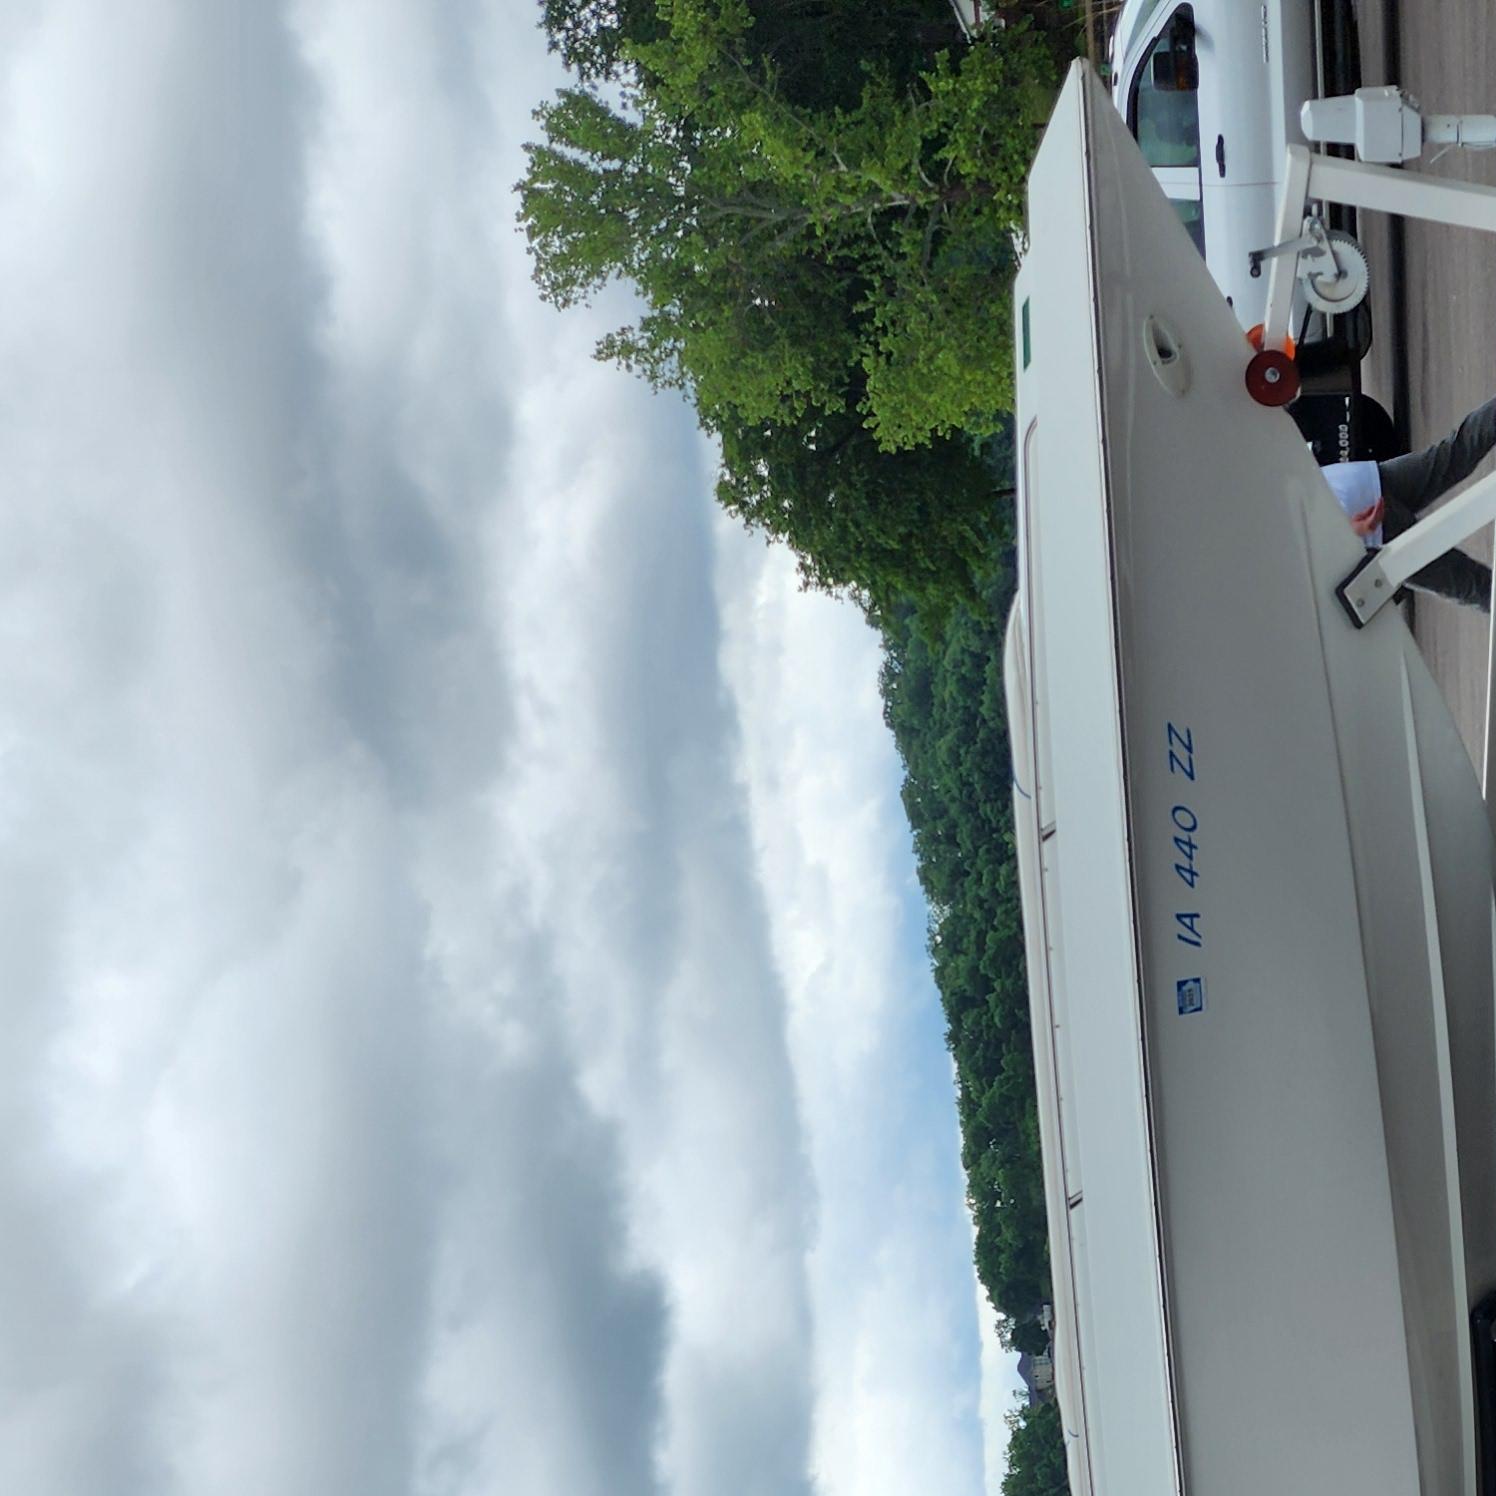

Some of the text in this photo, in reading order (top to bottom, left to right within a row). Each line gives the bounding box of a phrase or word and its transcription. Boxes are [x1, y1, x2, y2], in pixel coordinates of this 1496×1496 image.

[1167, 721, 1195, 780] ZZ
[1171, 804, 1199, 888] 440
[1175, 911, 1202, 947] IA
